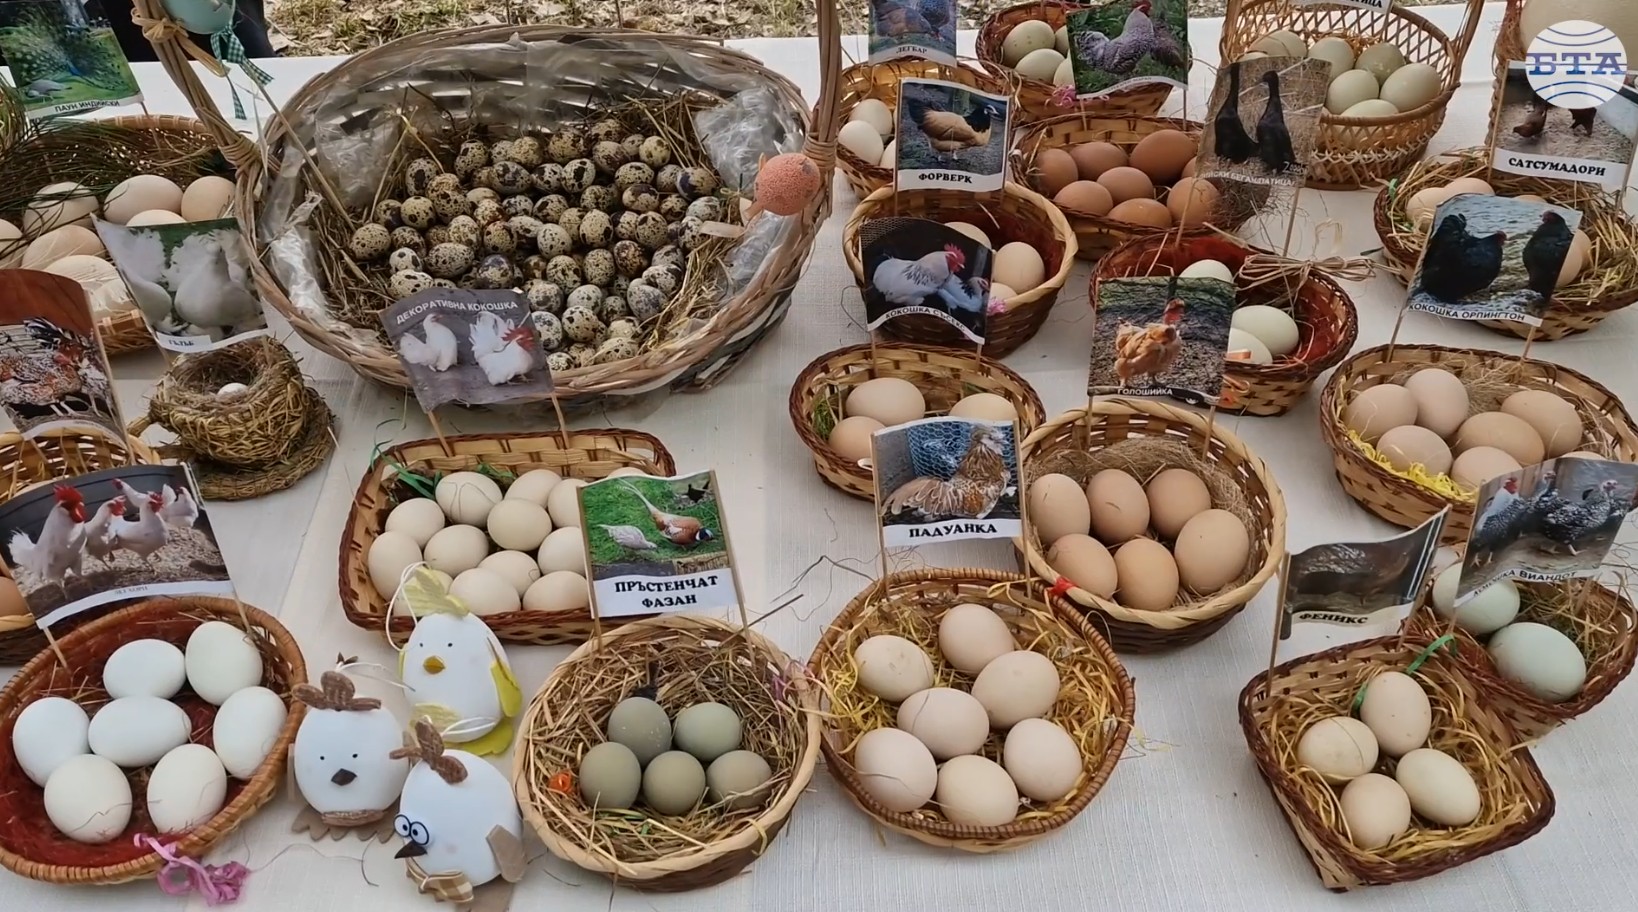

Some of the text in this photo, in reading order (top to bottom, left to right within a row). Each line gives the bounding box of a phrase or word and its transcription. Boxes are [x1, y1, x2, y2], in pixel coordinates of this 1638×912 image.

[55, 103, 78, 112] ПАУН
[1508, 157, 1606, 176] САТСУМАДОРИ
[918, 172, 973, 184] ФОРВЕРК
[396, 299, 518, 325] ДЕКОРАТИВНА КОКОШКА
[885, 306, 931, 319] КОКОШКА
[1408, 303, 1526, 321] КОКОШКА ОРПИНГТОН
[909, 523, 998, 538] ПАДУАНКА
[1519, 570, 1577, 582] ВИАНДОТ
[615, 575, 719, 592] ПРЪСТЕНЧАТ
[641, 594, 697, 608] ФАЗАН
[1299, 613, 1368, 624] ФЕНИКС
